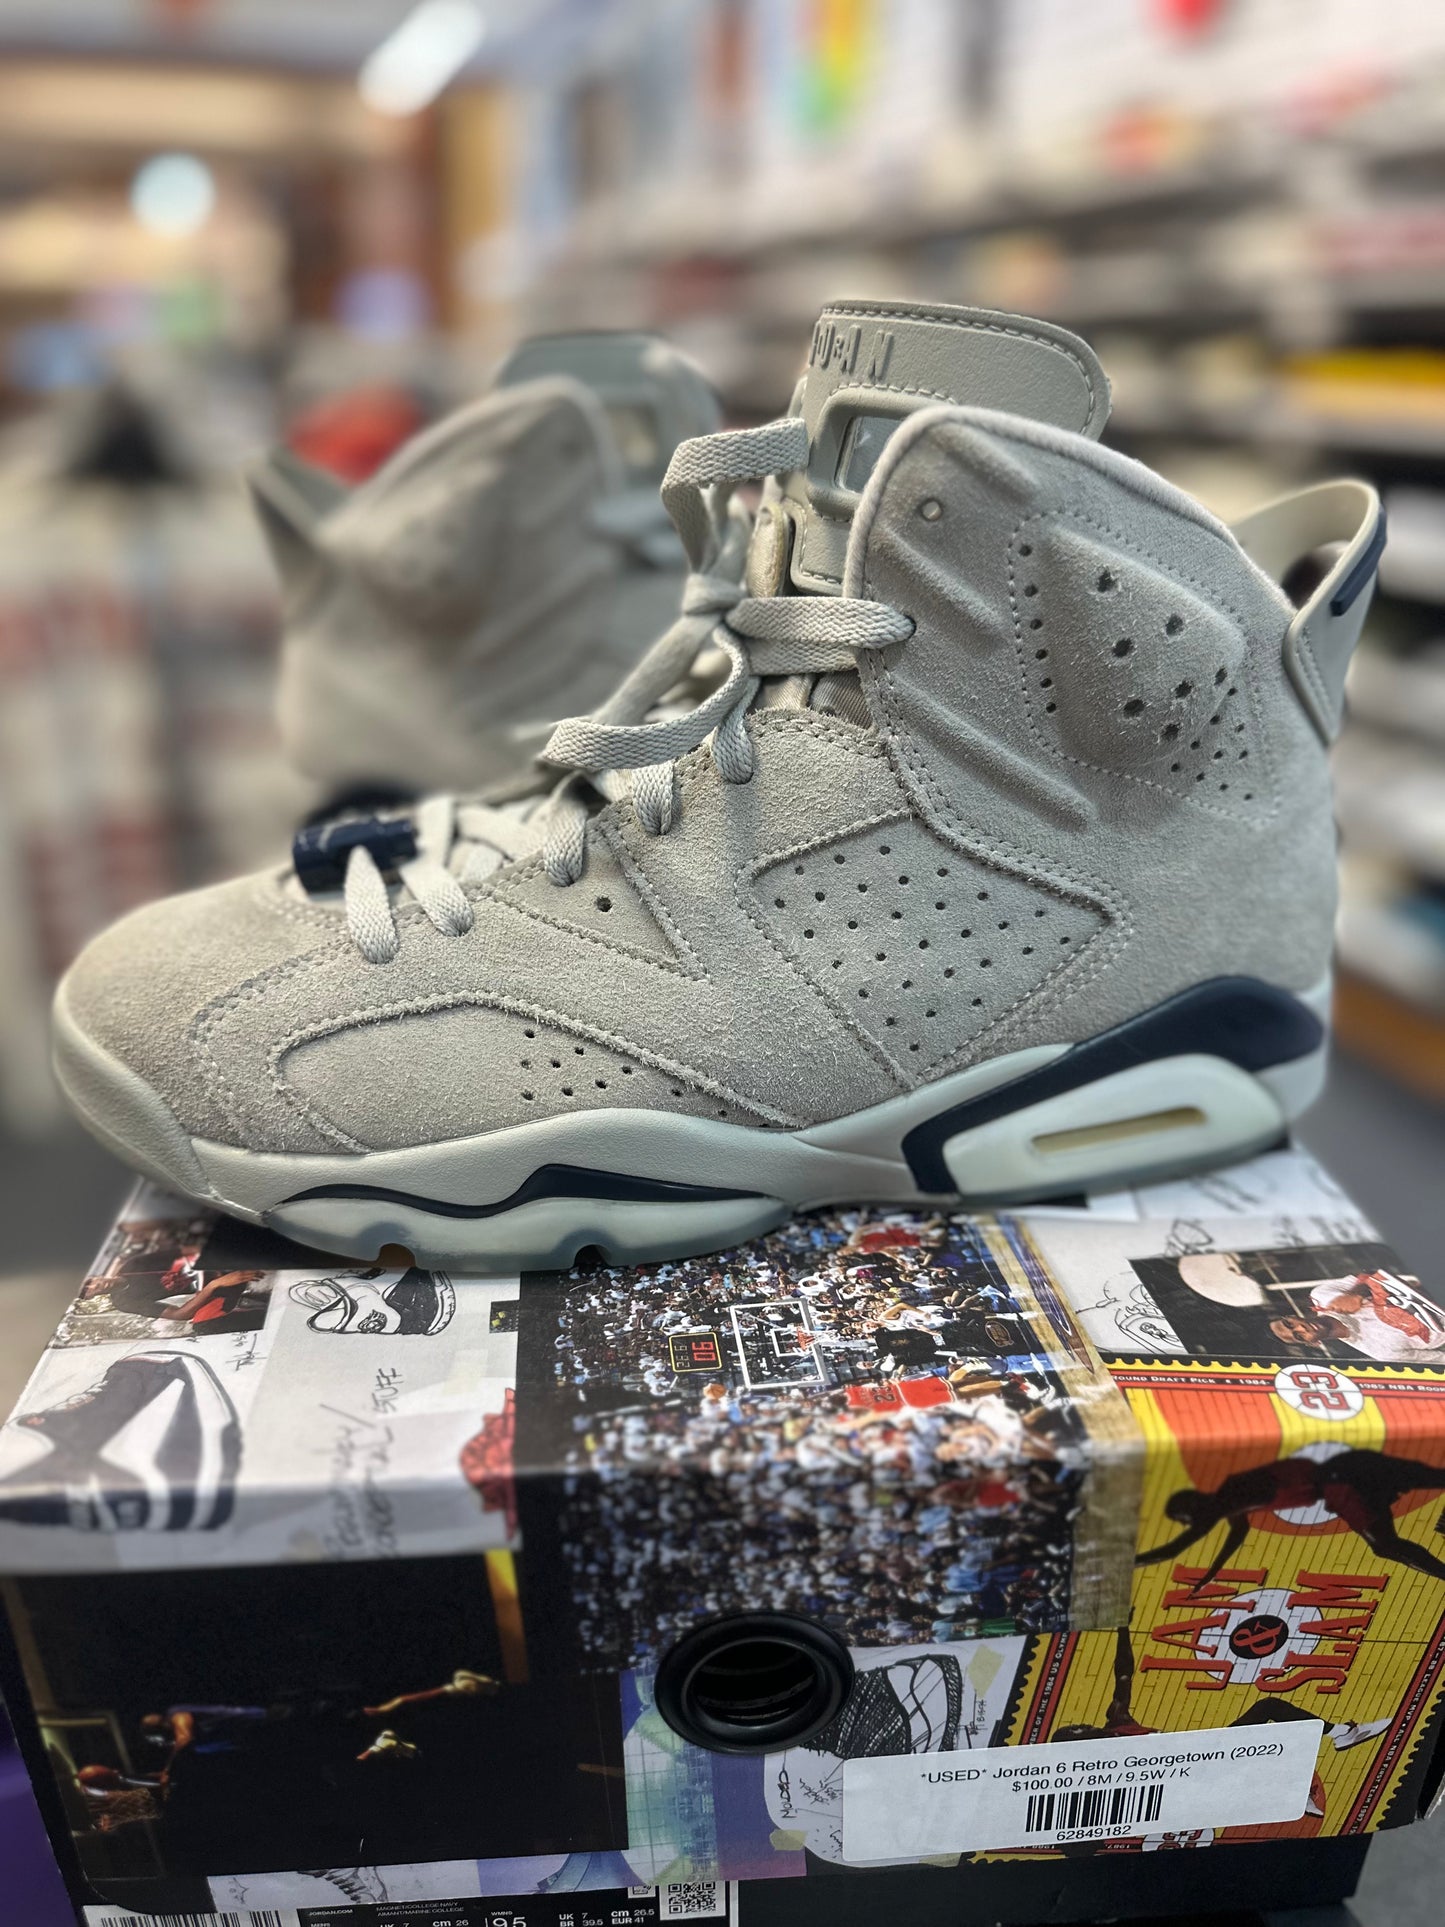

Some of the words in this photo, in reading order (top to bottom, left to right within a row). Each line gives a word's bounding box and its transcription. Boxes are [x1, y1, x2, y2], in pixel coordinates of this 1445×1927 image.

[1139, 1564, 1269, 1691] JAM
[1255, 1570, 1390, 1695] SLAM
[993, 1765, 1051, 1779] Jordan
[1055, 1762, 1067, 1774] 6
[1072, 1759, 1118, 1772] Retro
[1123, 1750, 1225, 1768] Georgetown
[1230, 1743, 1285, 1761] (2022)
[1012, 1777, 1073, 1793] $100.00
[1087, 1773, 1112, 1786] 8M
[1125, 1769, 1167, 1783] 9.5W
[1179, 1766, 1192, 1778] K
[1056, 1825, 1132, 1842] 62849182
[558, 1913, 574, 1921] UK
[611, 1917, 633, 1925] EUR
[634, 1916, 645, 1924] 41
[633, 1908, 655, 1917] 26.5
[455, 1919, 469, 1927] 26
